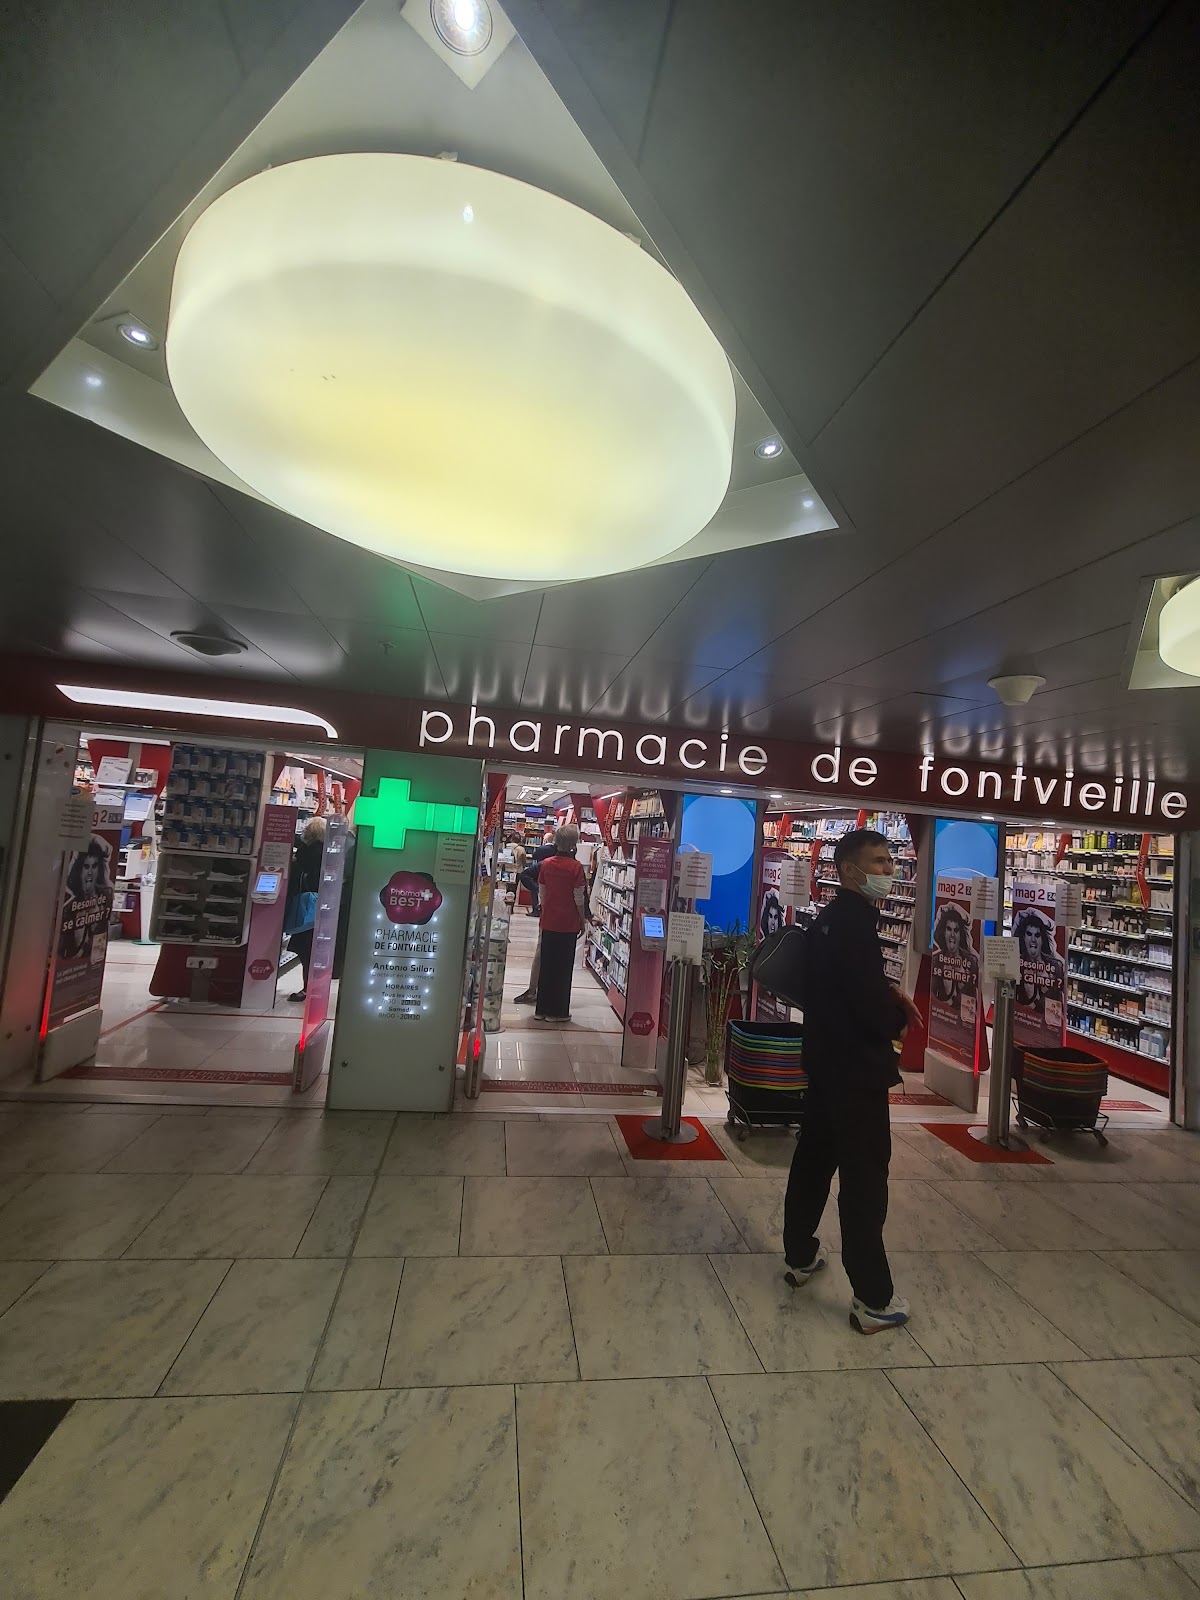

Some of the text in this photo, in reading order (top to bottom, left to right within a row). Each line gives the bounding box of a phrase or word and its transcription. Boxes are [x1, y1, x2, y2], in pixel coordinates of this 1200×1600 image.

[418, 706, 1188, 819] pharmacie de fontvieille
[765, 868, 777, 882] mag
[390, 888, 420, 897] Pharma
[937, 882, 956, 896] mag
[957, 882, 965, 895] 2
[1015, 888, 1036, 902] mag
[1037, 889, 1045, 900] 2
[71, 895, 106, 911] Besoin de
[62, 918, 74, 931] se
[76, 909, 104, 927] calmer
[376, 929, 438, 944] PHARMACIE
[374, 942, 438, 953] DE FONTVIEILLE
[373, 963, 408, 971] Antonio
[939, 953, 972, 968] Besoin de
[1020, 959, 1056, 973] Besoin de
[933, 967, 942, 976] se
[943, 969, 971, 982] calmer
[1024, 973, 1056, 987] calmer
[1057, 978, 1063, 989] ?
